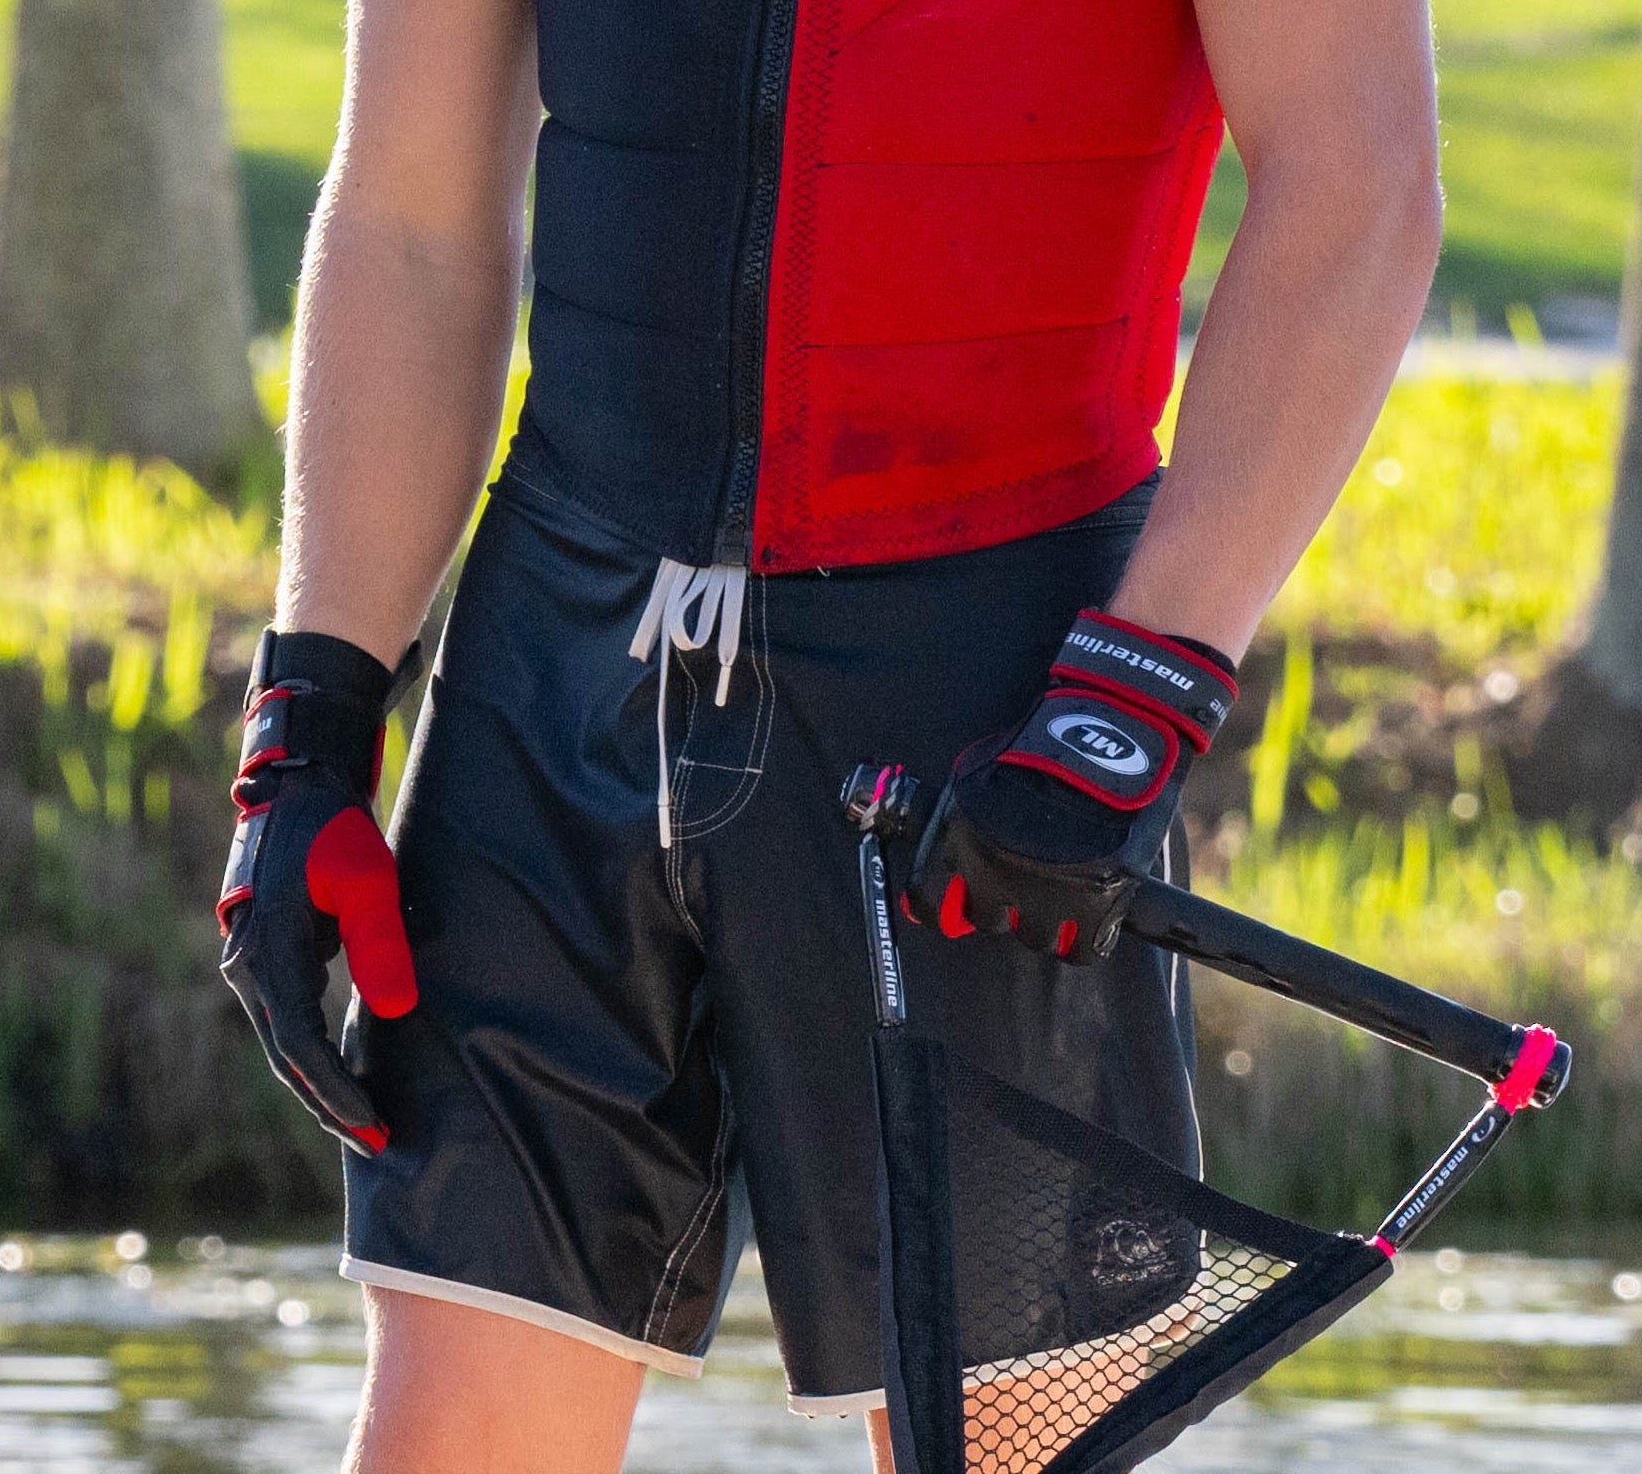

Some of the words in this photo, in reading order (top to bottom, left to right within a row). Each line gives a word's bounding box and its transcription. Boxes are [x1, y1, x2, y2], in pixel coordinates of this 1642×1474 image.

[1081, 725, 1124, 758] ML
[875, 899, 898, 1007] masterline
[1395, 1146, 1469, 1229] masterline
